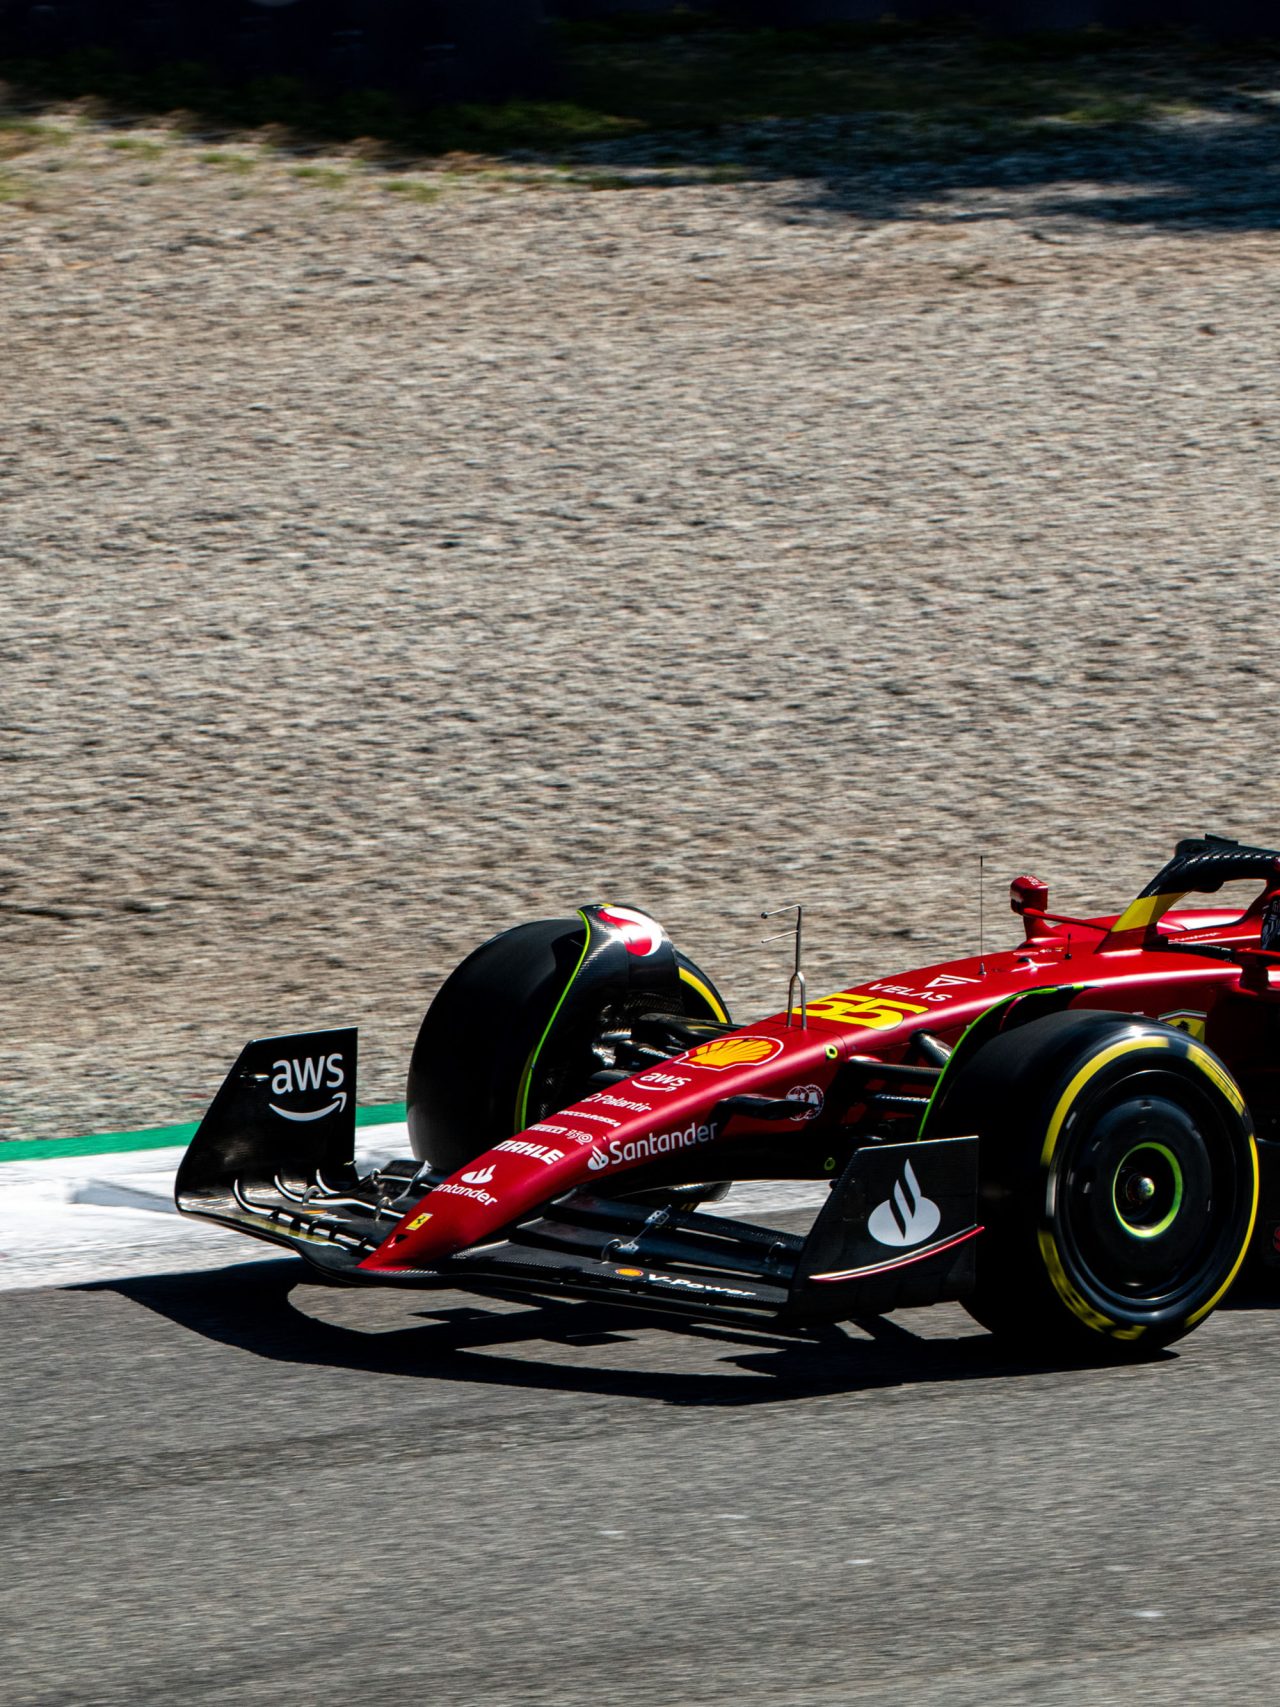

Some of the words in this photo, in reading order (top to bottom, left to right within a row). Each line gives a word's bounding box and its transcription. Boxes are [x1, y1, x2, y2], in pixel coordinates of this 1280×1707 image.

[868, 983, 953, 1003] VELAS
[783, 992, 930, 1032] 55
[272, 1052, 345, 1095] aws
[640, 1072, 692, 1088] aws
[593, 1093, 653, 1113] Palantir
[492, 1139, 566, 1165] MAHLE
[609, 1121, 718, 1165] Santander
[431, 1182, 499, 1206] antander
[648, 1273, 757, 1297] V-Power
